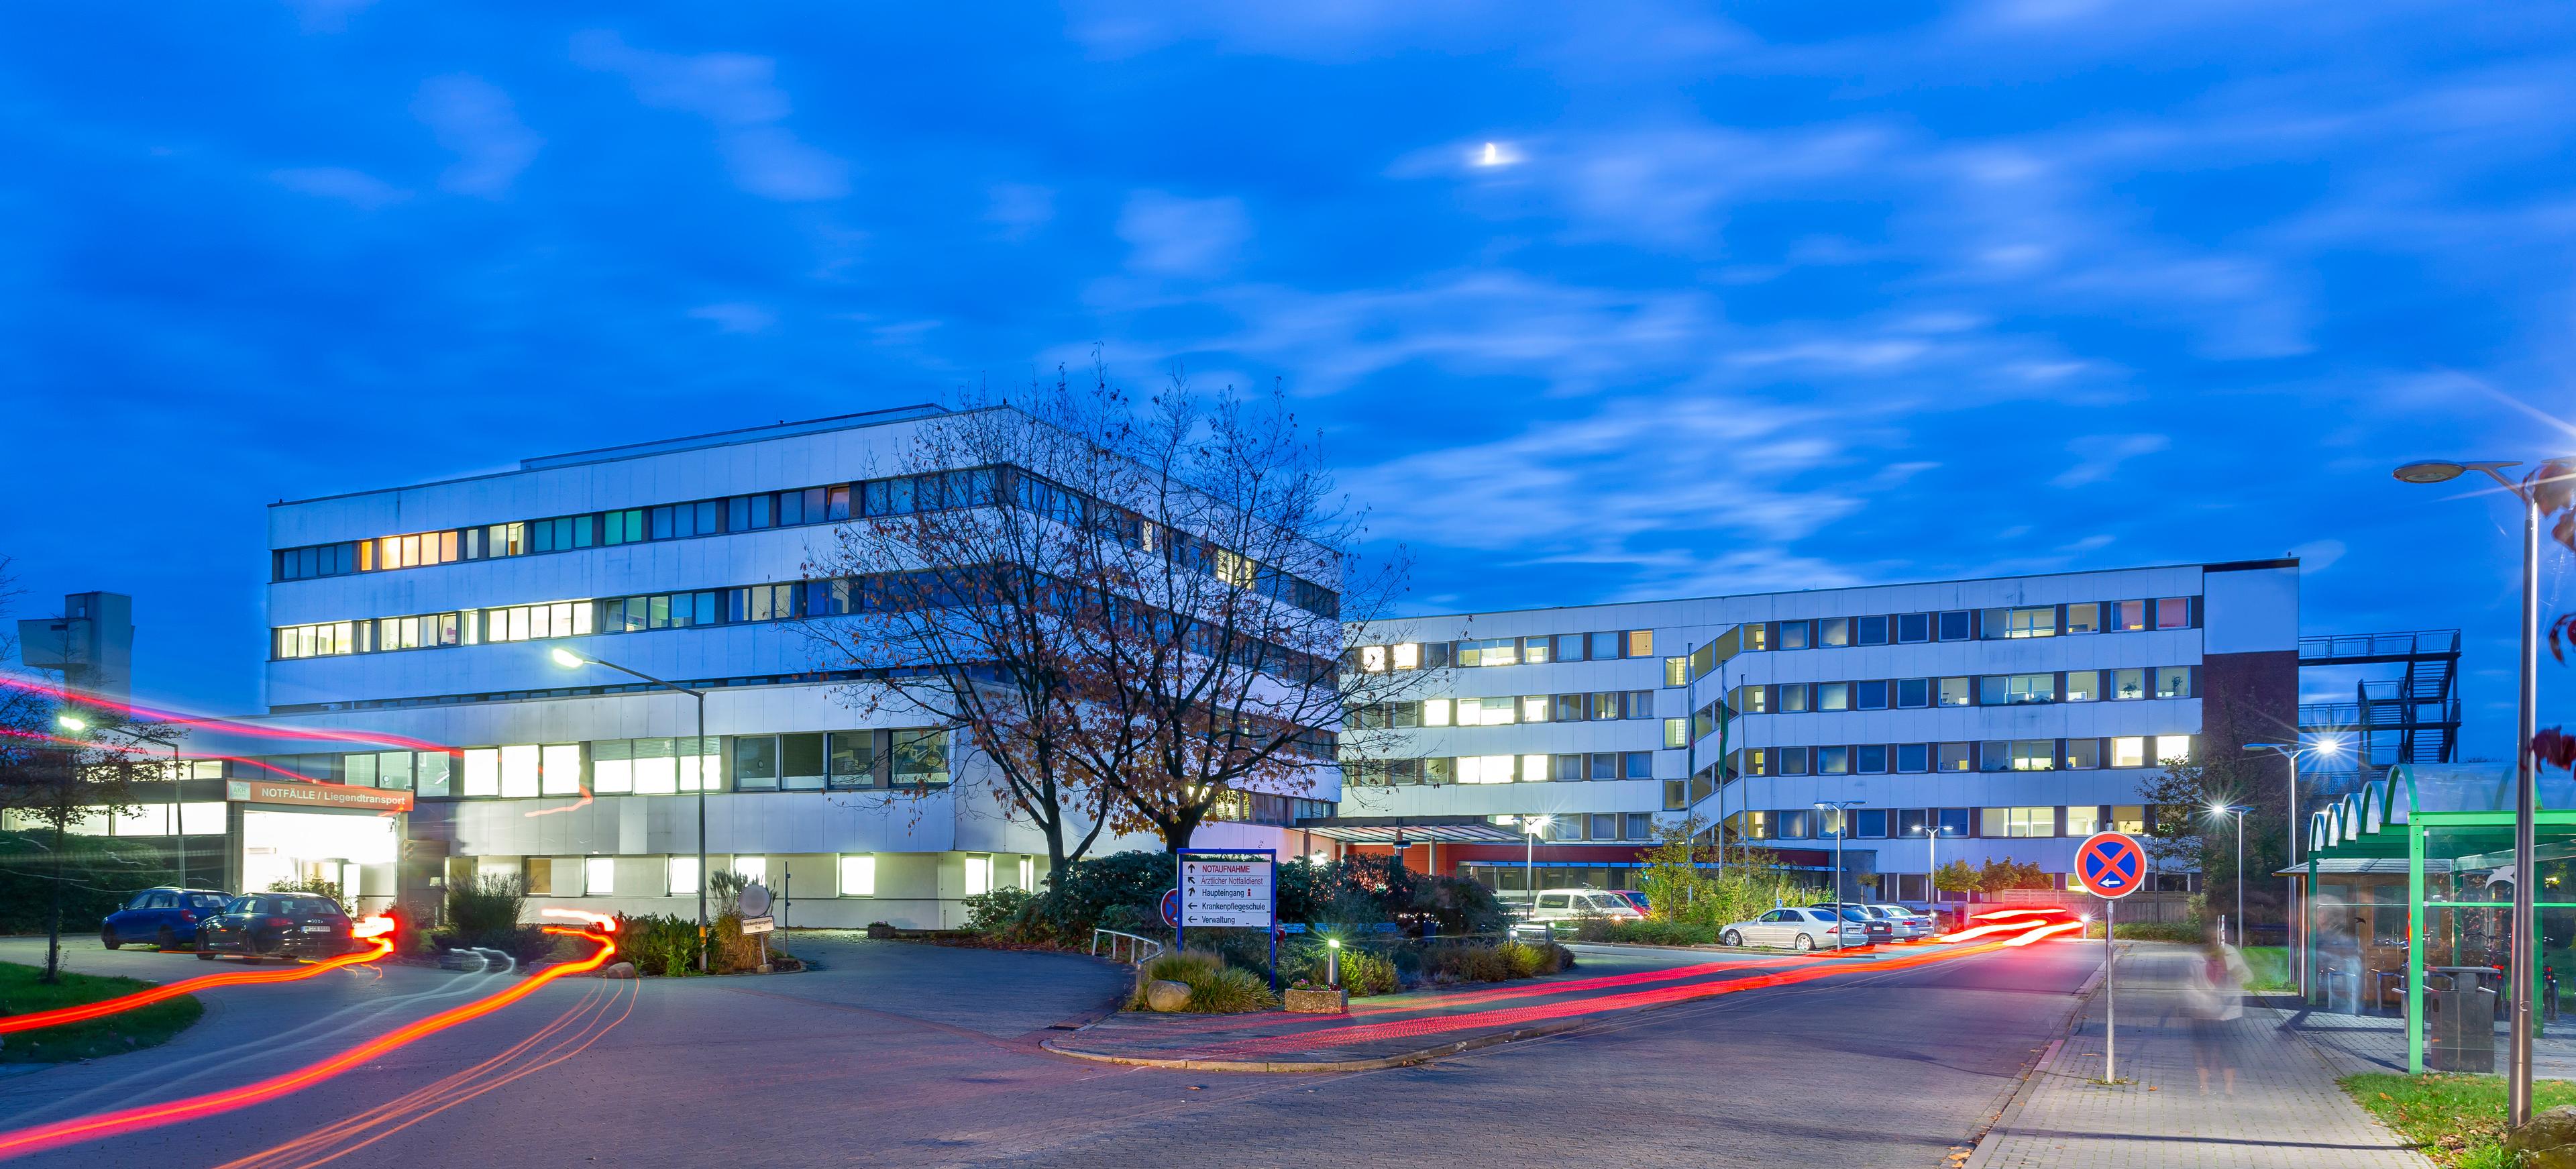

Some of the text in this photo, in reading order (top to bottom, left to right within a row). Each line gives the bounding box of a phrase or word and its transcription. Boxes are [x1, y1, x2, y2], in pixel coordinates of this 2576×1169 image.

[262, 788, 405, 805] NOTFÄLLE / Liegendtransport
[1202, 865, 1250, 873] NOTAUFNAHME
[1201, 876, 1263, 884] Ärztlicher Notfalldienst
[1202, 888, 1244, 898] Haupteingang
[1202, 903, 1266, 911] Krankenpflegeschule
[1201, 916, 1236, 925] Verwaltung
